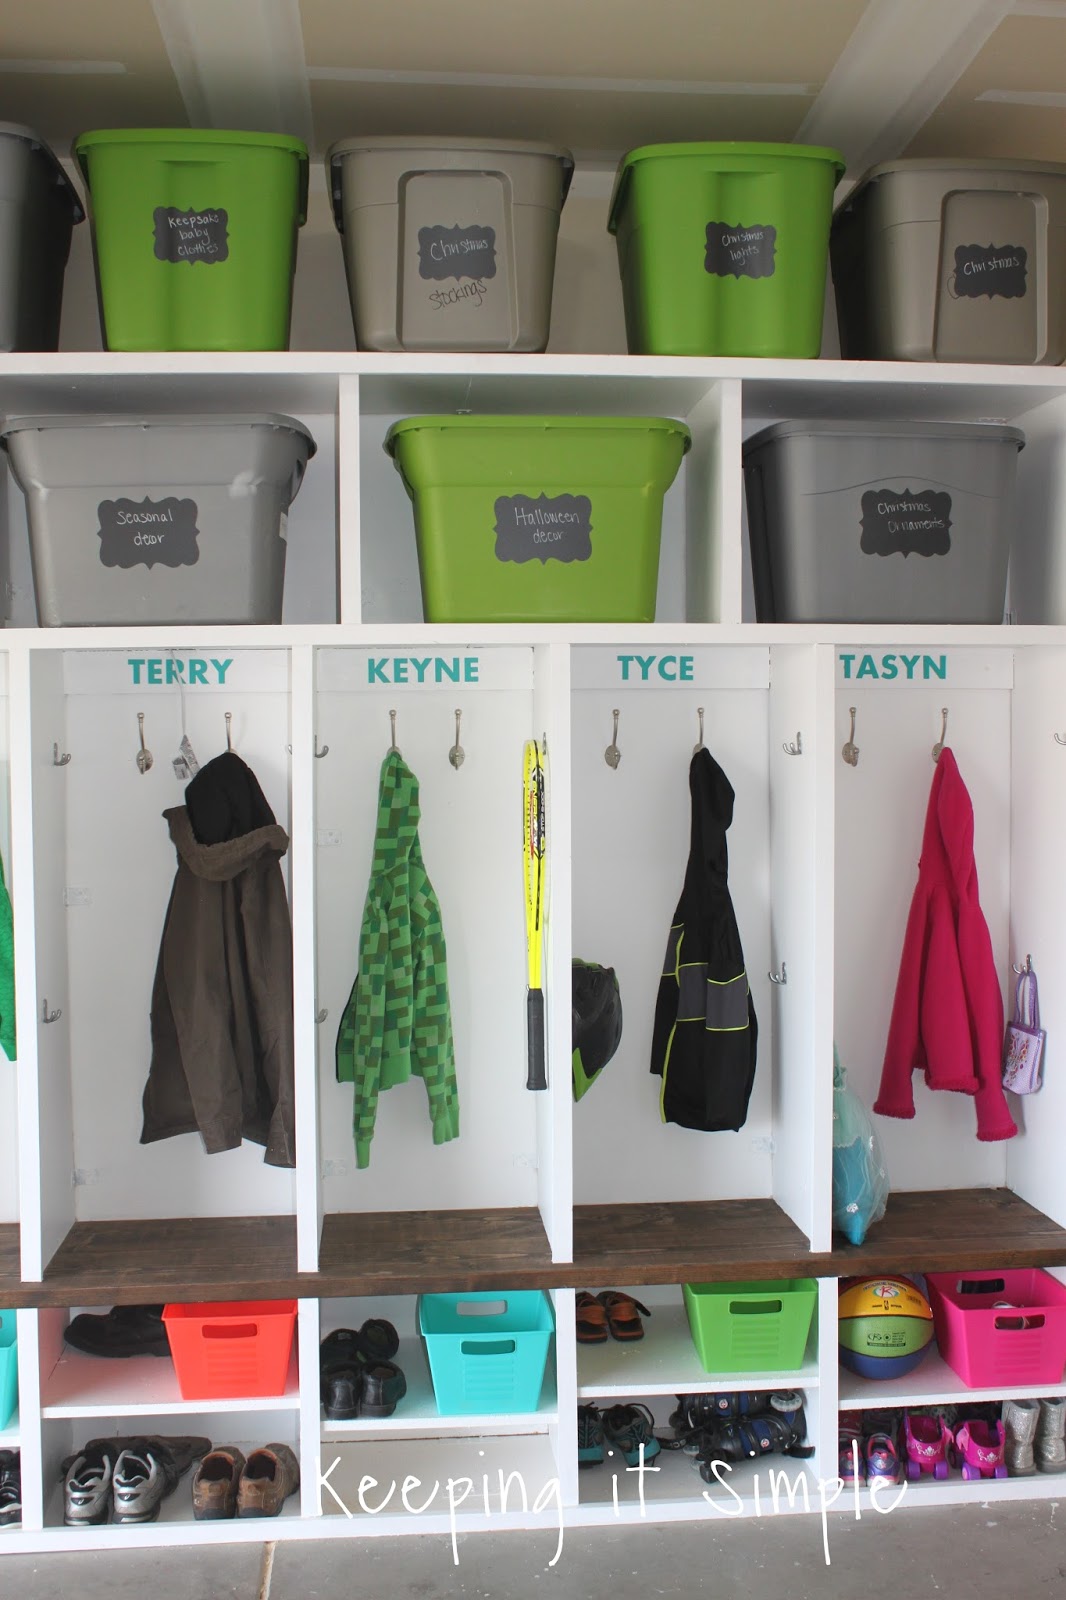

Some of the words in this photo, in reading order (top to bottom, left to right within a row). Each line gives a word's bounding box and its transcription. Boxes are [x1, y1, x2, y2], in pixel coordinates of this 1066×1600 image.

[179, 228, 211, 246] baby
[116, 508, 173, 525] Seasonal
[514, 506, 580, 526] Halloween
[877, 501, 932, 515] Christmas
[133, 531, 165, 546] decor
[532, 528, 564, 544] decor
[127, 658, 234, 685] TERRY
[367, 657, 479, 684] KEYNE
[617, 655, 694, 681] TYCE
[839, 654, 947, 680] TASYN
